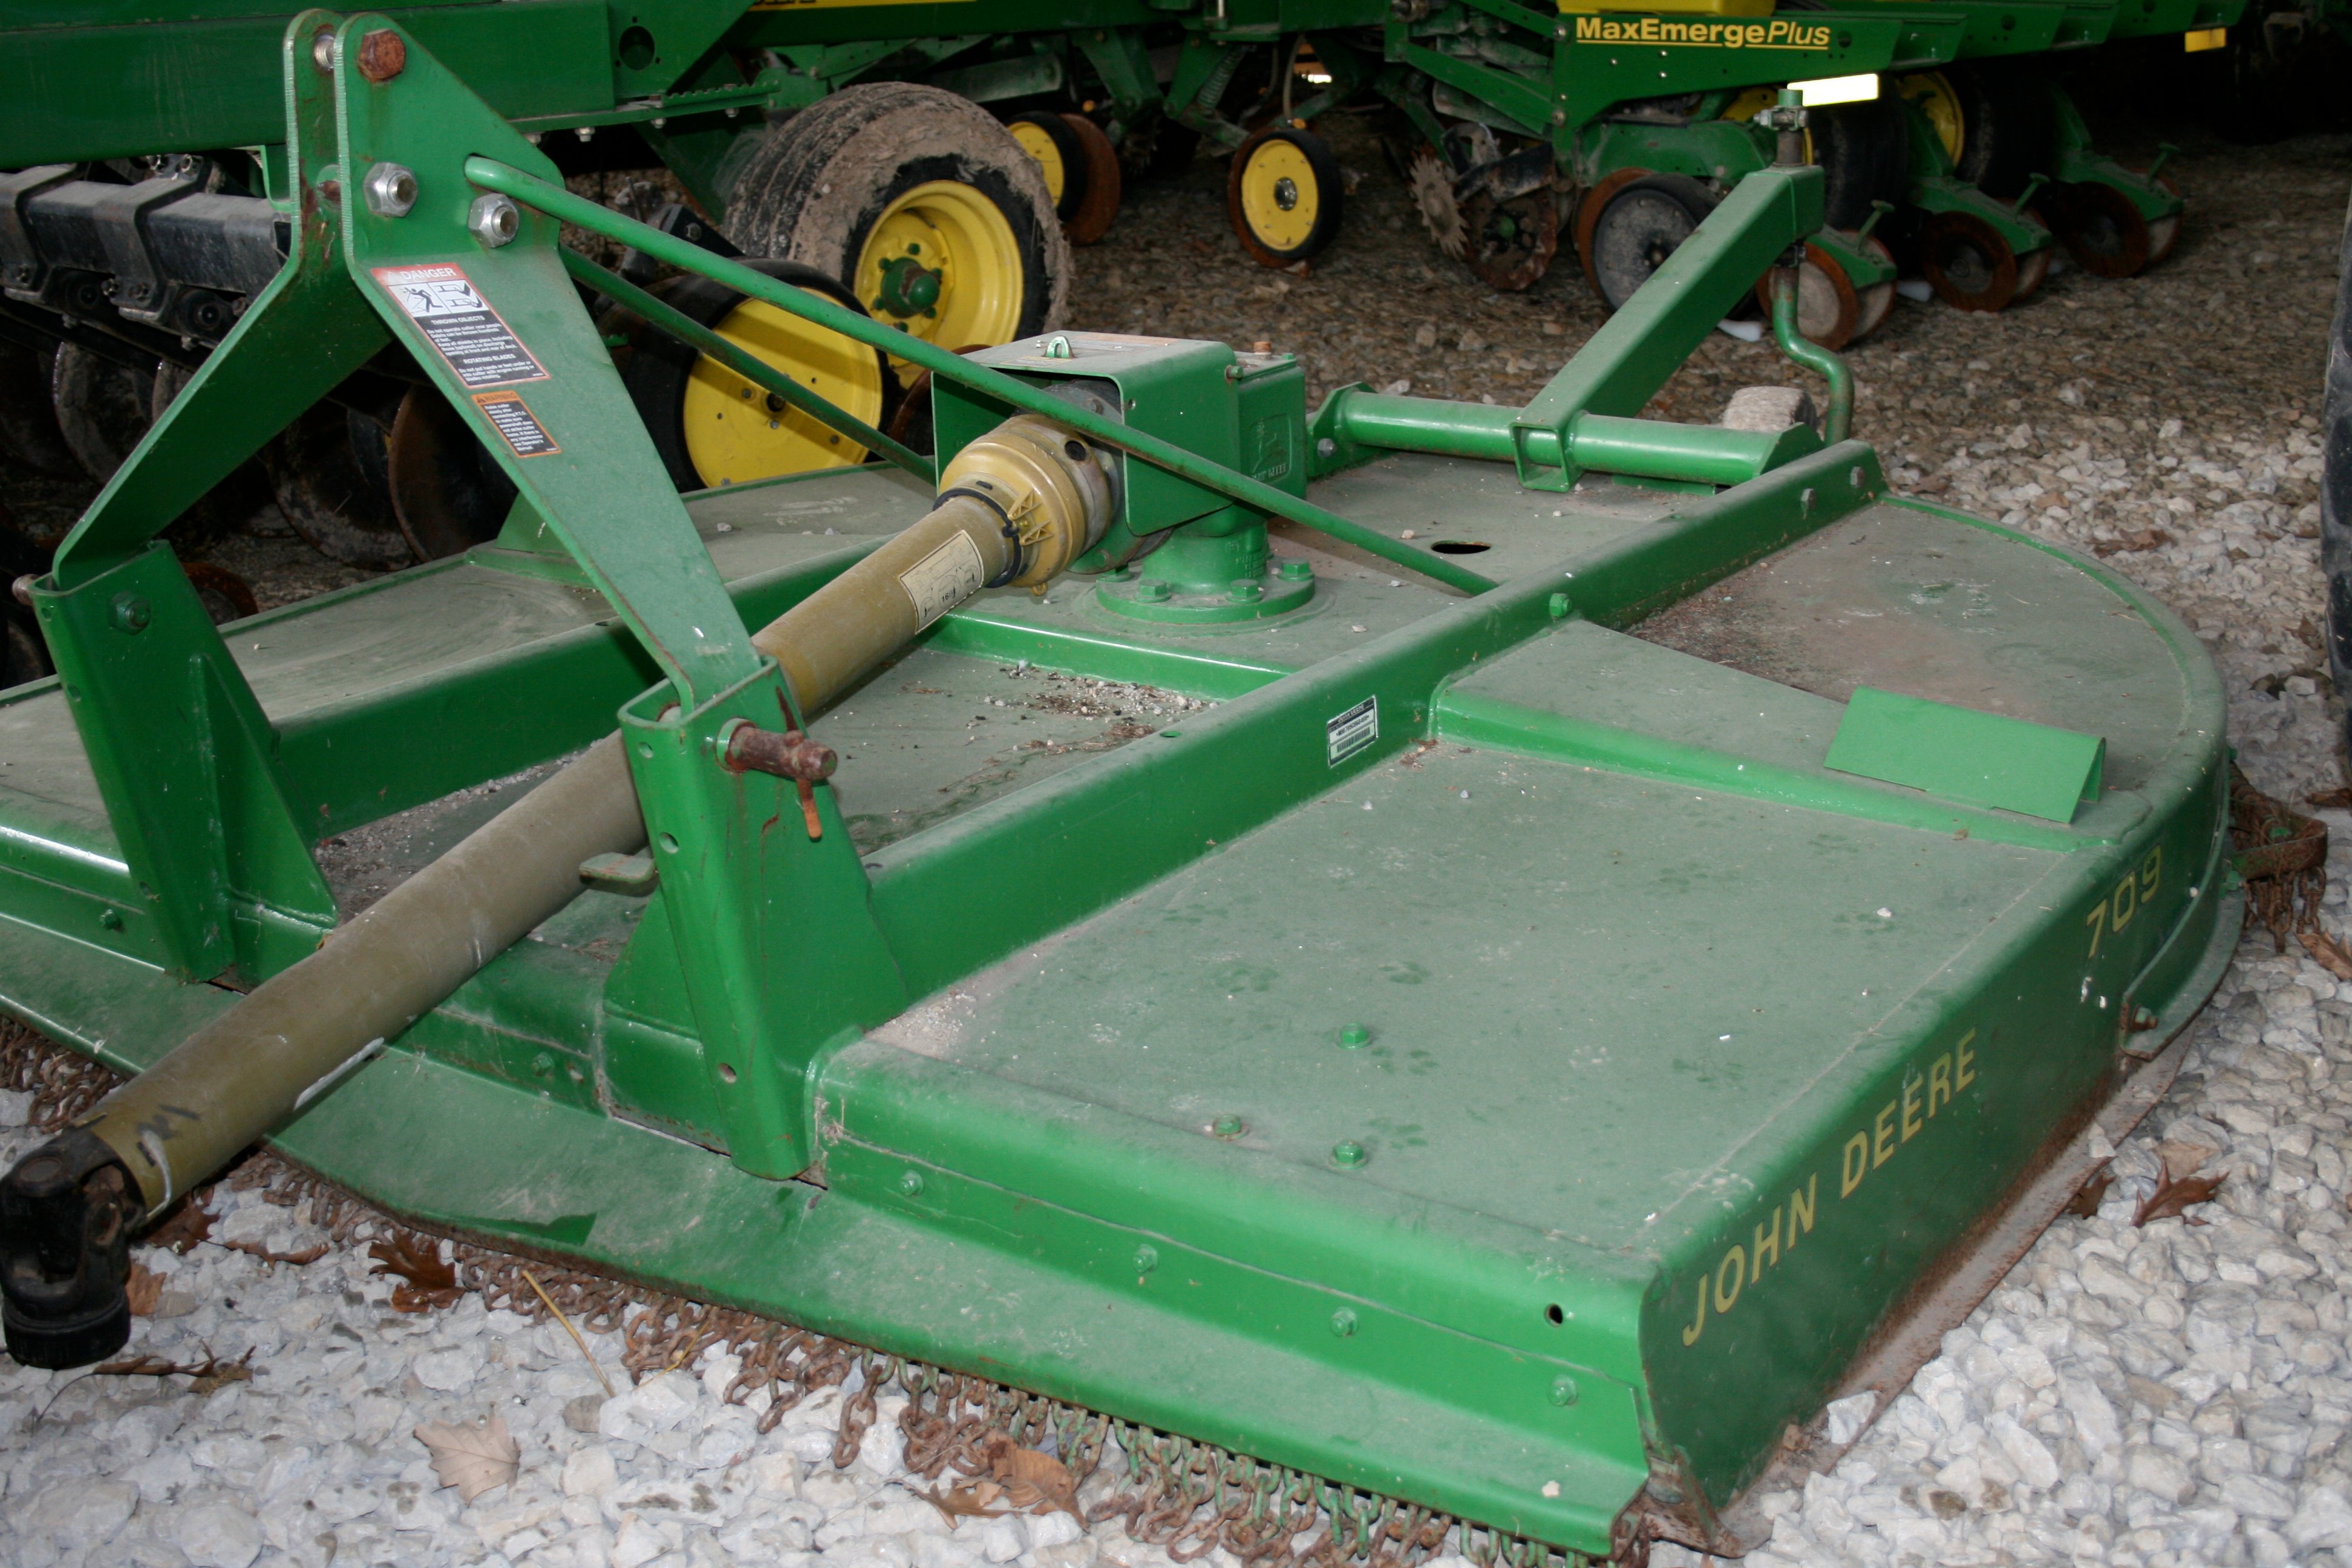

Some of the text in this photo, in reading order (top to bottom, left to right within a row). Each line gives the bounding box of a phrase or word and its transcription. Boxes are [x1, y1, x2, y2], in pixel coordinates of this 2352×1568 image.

[400, 268, 456, 280] DANGER
[2086, 844, 2161, 959] 709
[1682, 1027, 1976, 1347] JOHN DEERE
